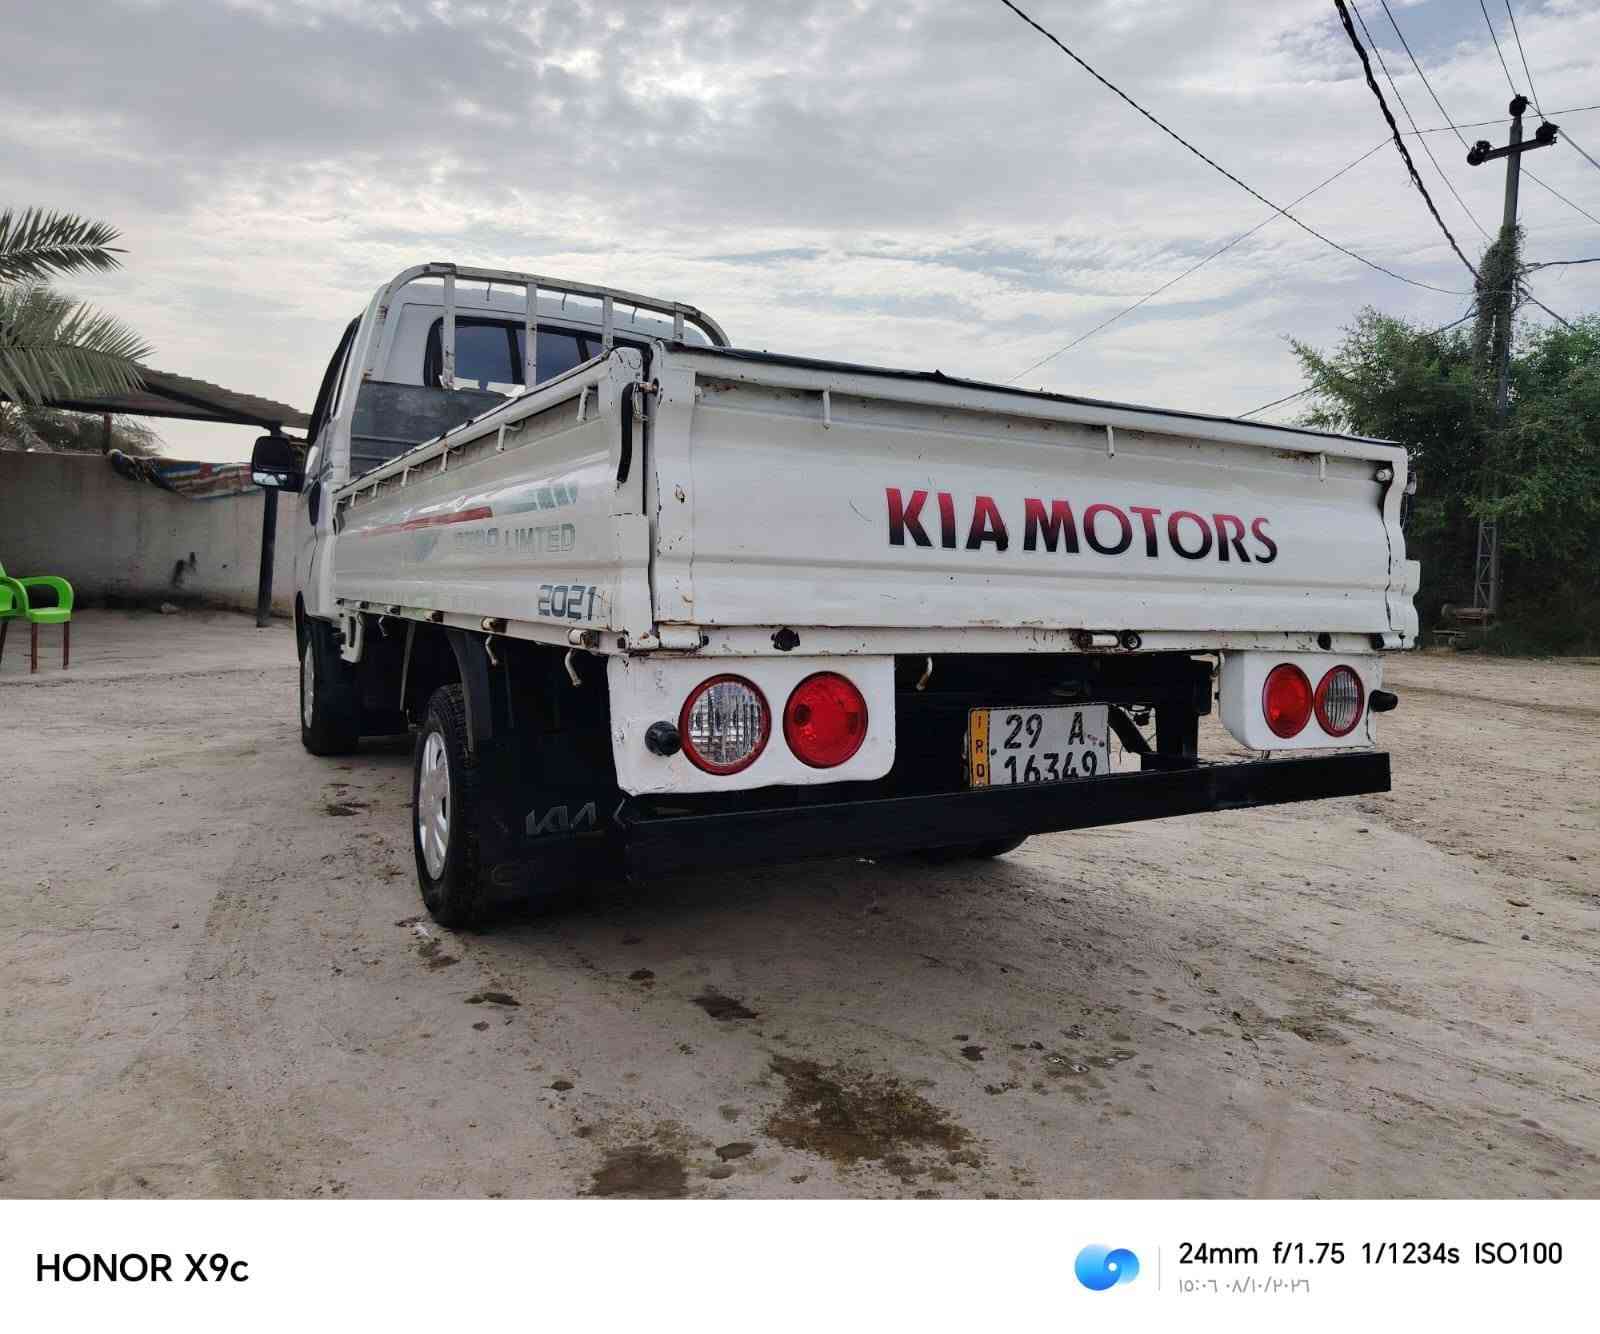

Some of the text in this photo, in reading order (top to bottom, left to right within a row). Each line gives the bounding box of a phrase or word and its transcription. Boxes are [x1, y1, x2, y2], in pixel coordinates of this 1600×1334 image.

[885, 487, 1279, 564] KIA MOTORS
[538, 584, 598, 621] 2021
[1004, 711, 1085, 750] 29 A
[1004, 750, 1098, 785] 16349
